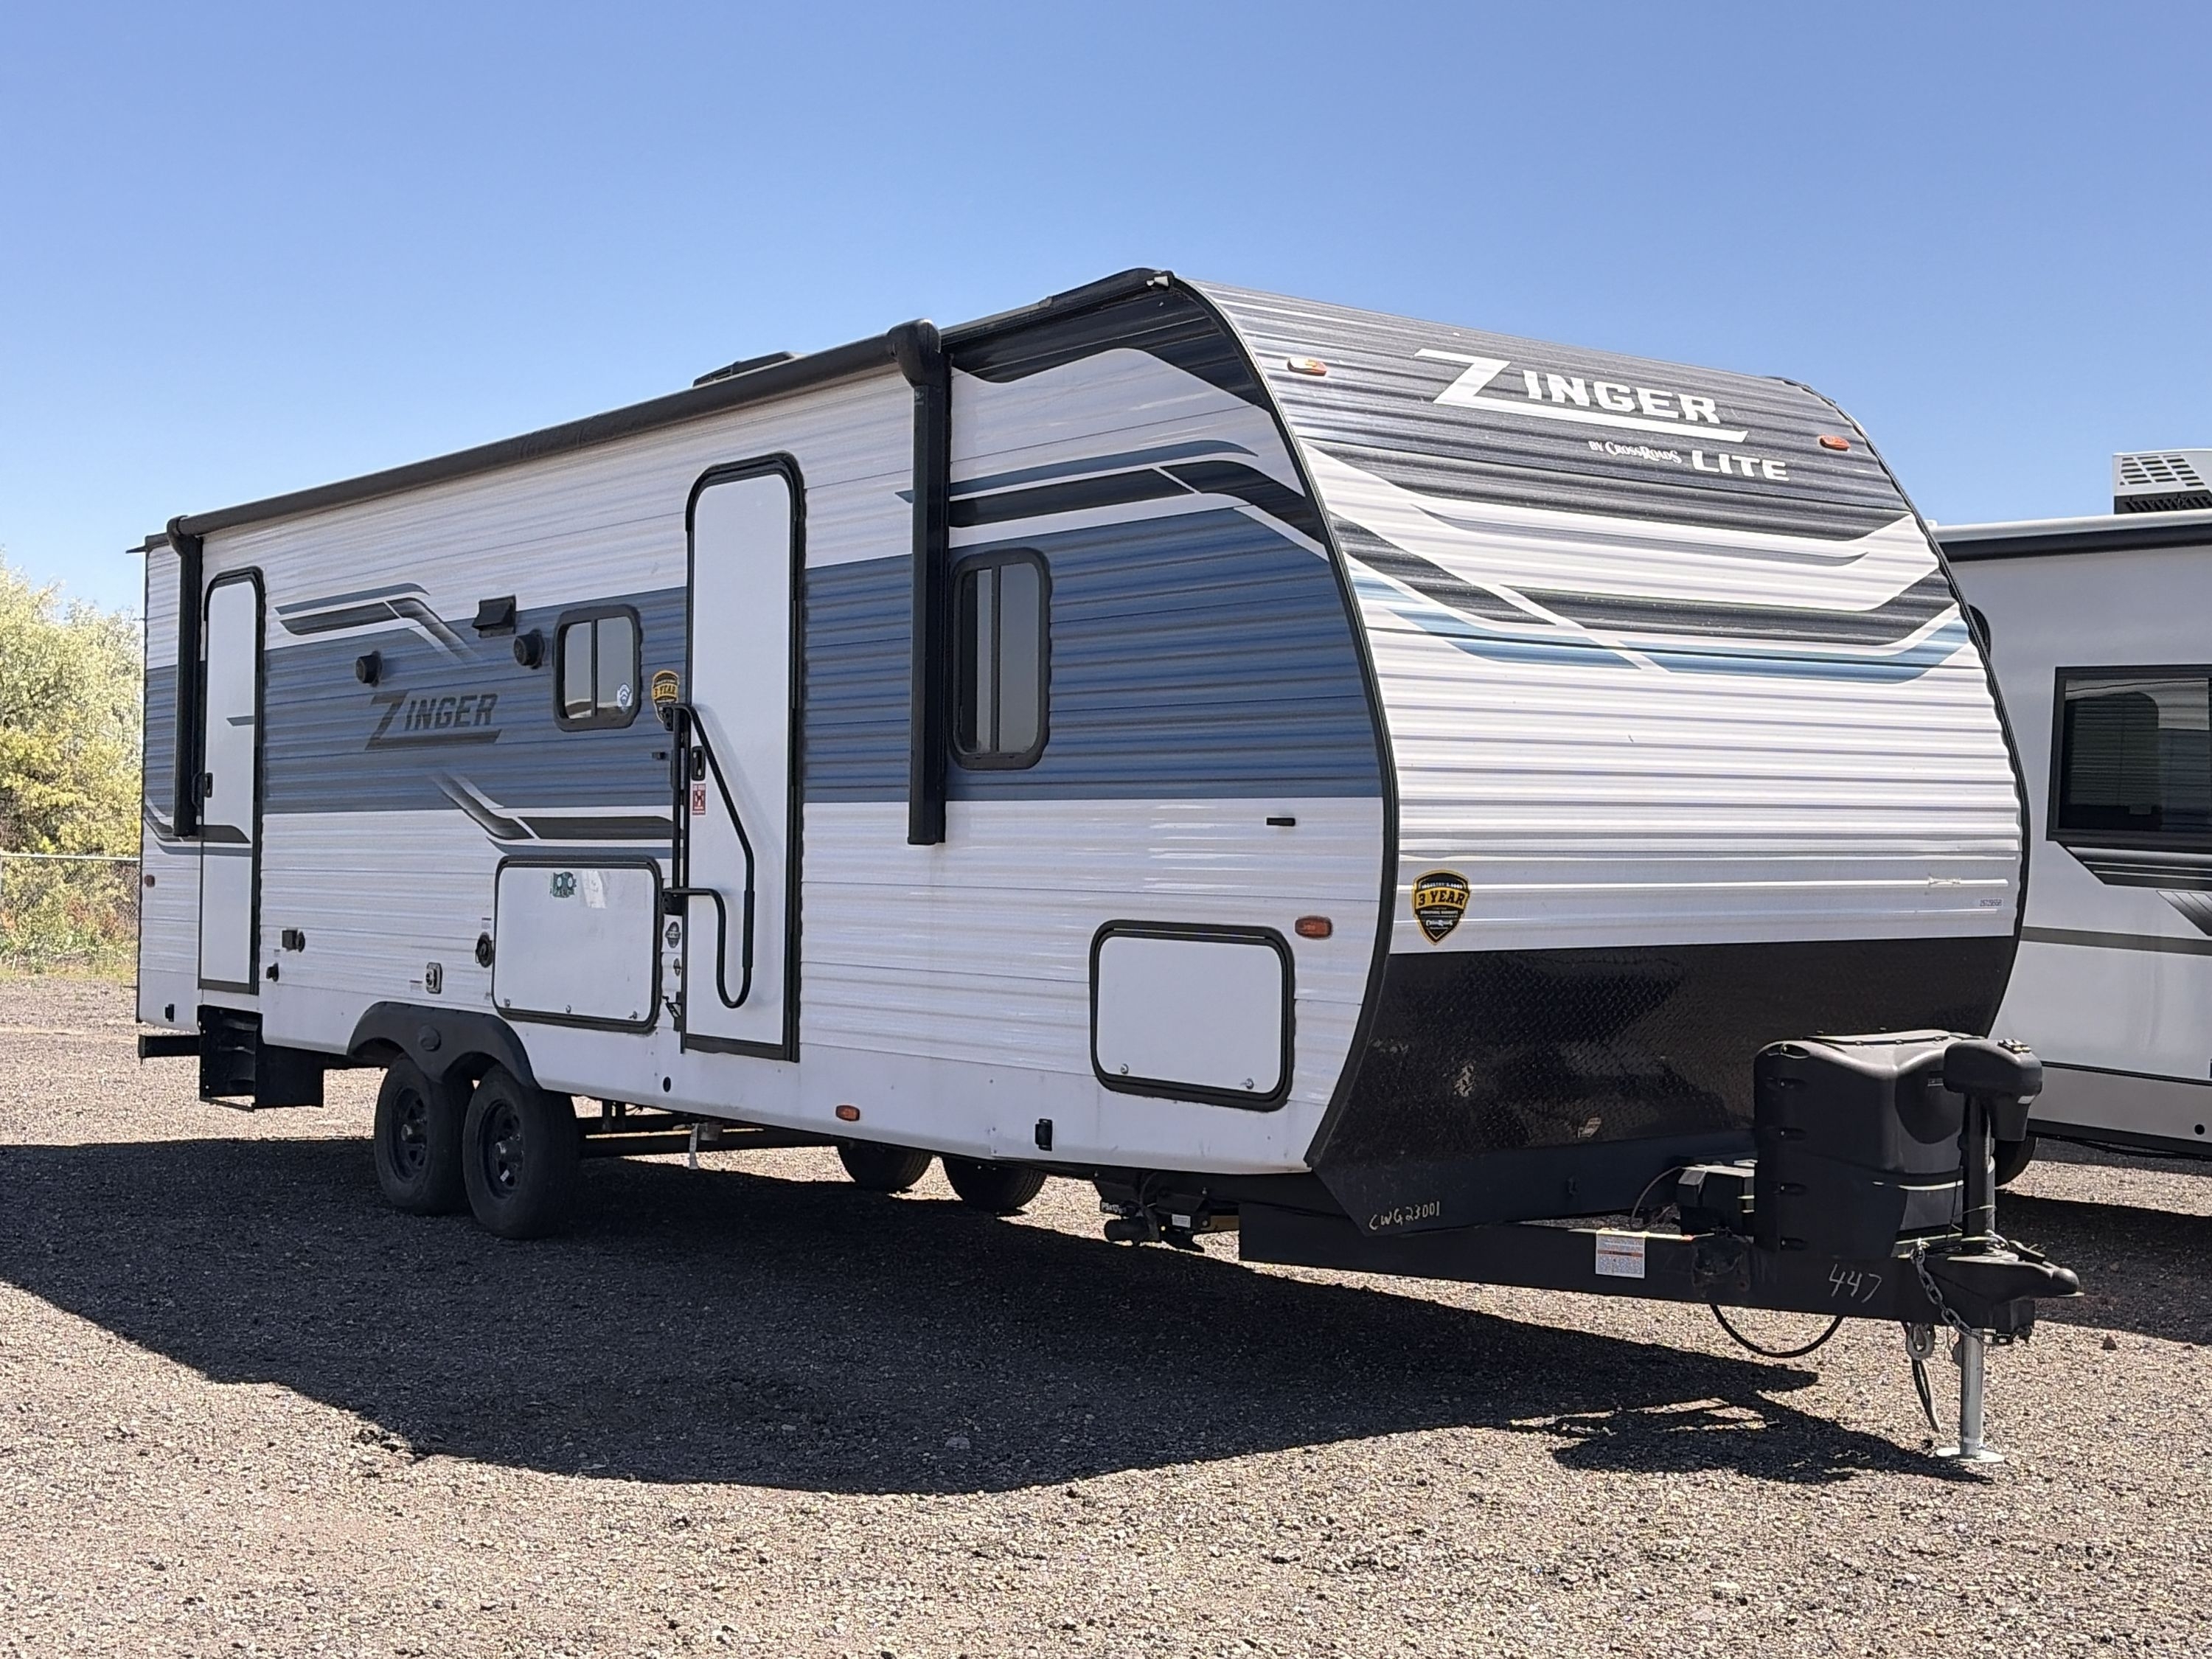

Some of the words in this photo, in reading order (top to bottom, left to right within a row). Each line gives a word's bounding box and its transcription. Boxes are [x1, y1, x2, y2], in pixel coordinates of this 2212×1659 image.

[1413, 348, 1748, 442] ZINGER
[1587, 440, 1604, 452] BY
[1691, 449, 1790, 481] LITE
[364, 689, 502, 751] ZINGER
[1417, 893, 1426, 906] 3
[1430, 889, 1466, 906] YEAR
[1368, 1200, 1440, 1231] CWG23001
[1829, 1263, 1882, 1304] 447
